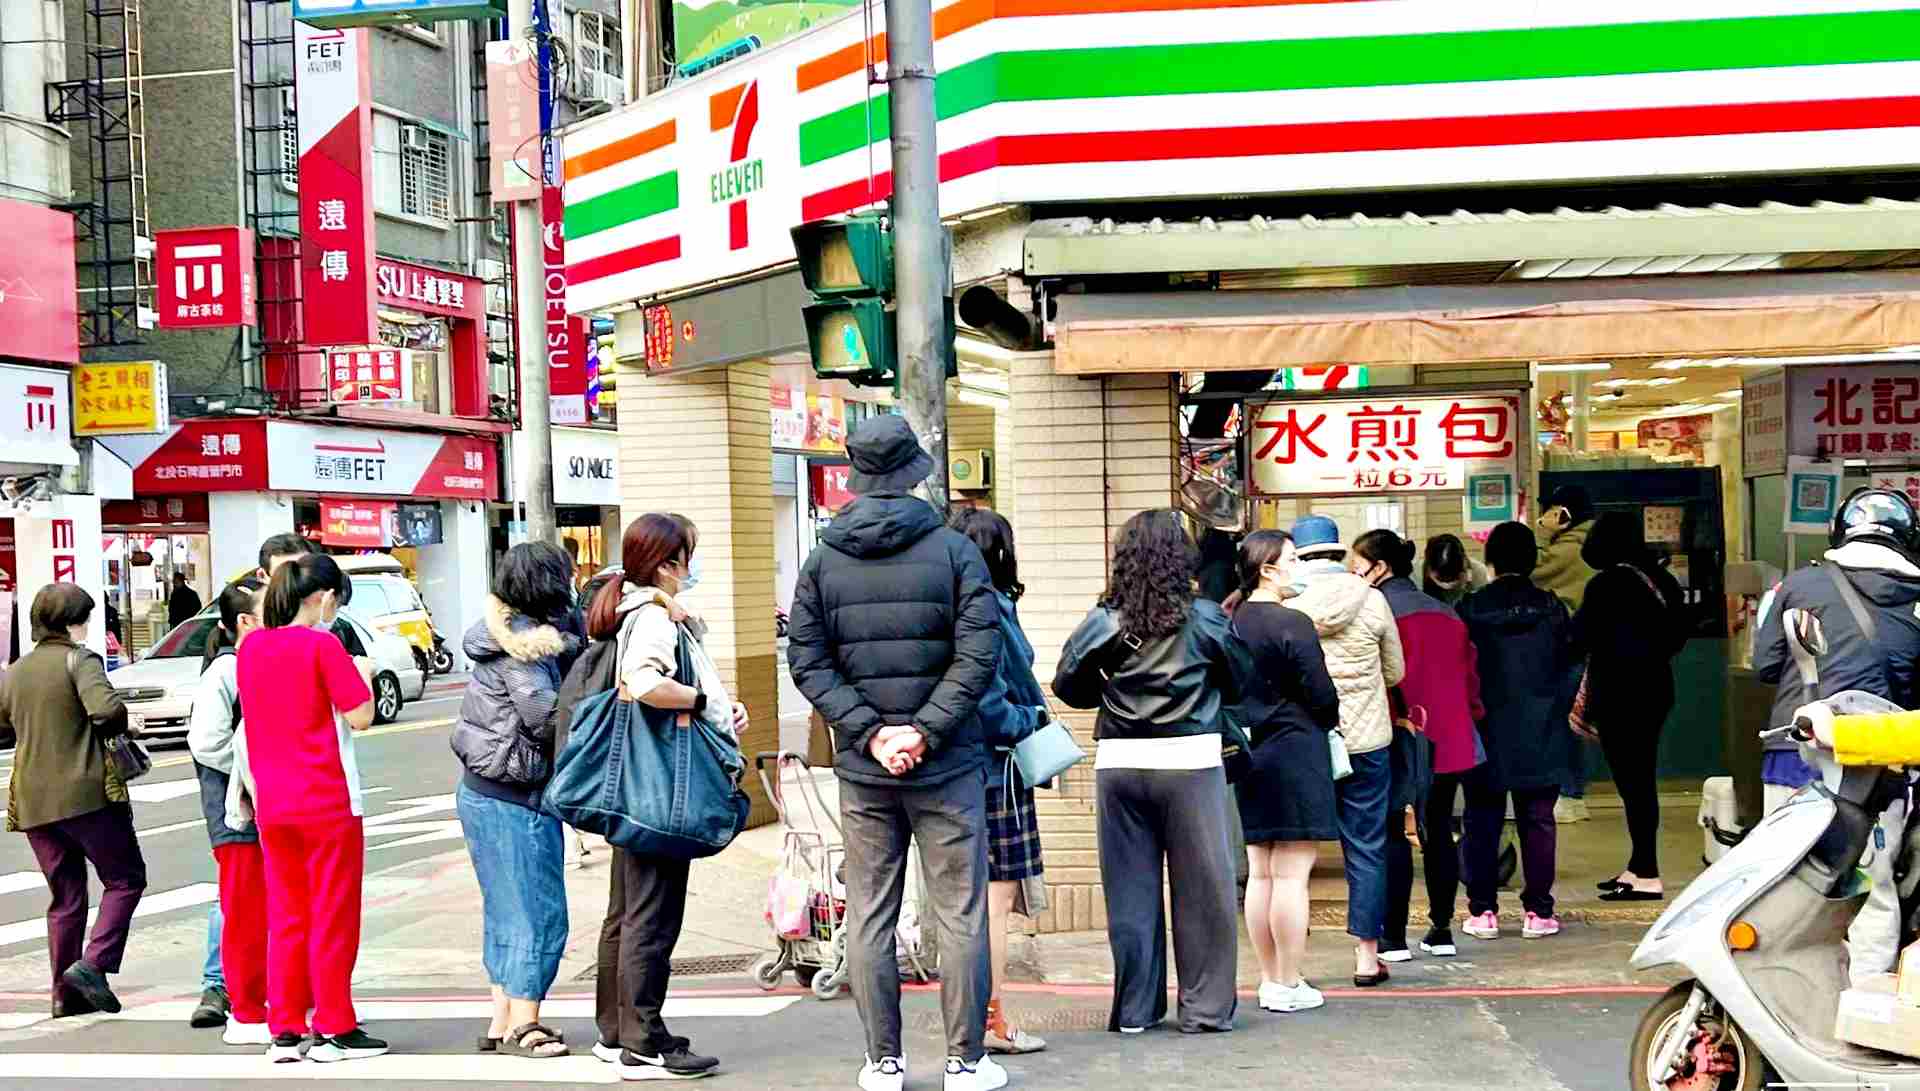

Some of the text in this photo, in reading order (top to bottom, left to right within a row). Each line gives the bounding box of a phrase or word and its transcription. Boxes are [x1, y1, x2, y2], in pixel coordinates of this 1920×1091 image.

[307, 42, 345, 59] FET
[318, 200, 349, 282] 遠傳
[544, 263, 569, 369] JOETSU
[1814, 377, 1920, 427] 北記
[201, 433, 242, 456] 遠傳
[1255, 402, 1514, 464] 水煎包
[568, 455, 614, 479] SO NICE
[1320, 465, 1447, 488] 一粒6元
